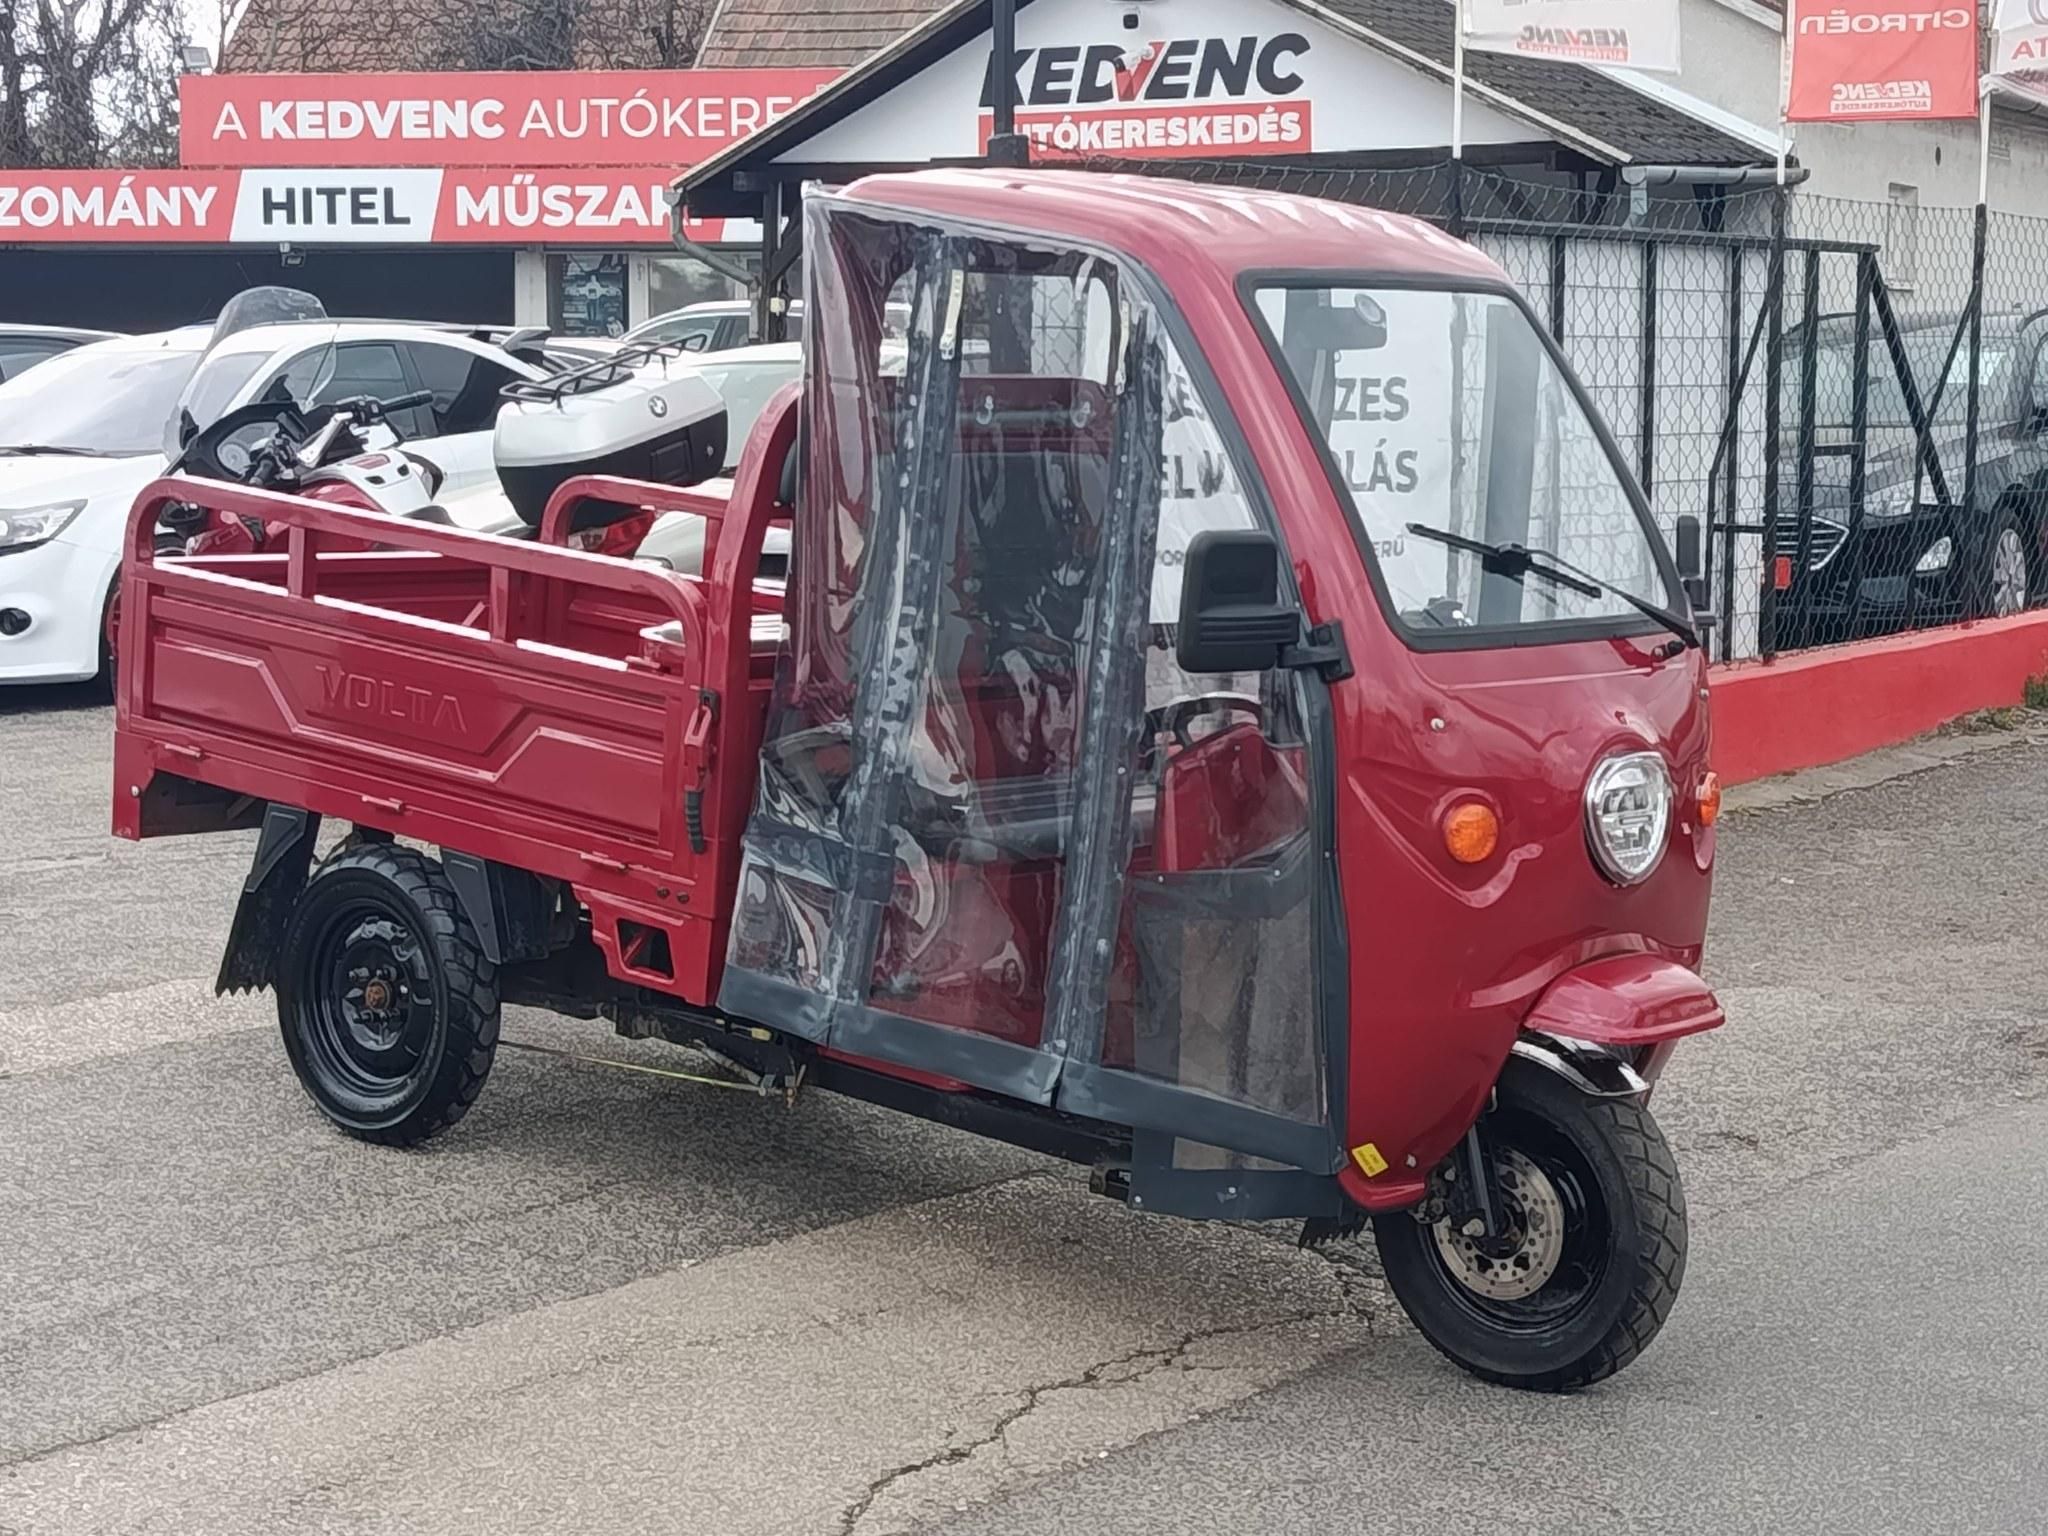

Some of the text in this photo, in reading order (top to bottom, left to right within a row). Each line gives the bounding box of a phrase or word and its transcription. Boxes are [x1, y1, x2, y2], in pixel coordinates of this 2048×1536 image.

[979, 33, 1311, 107] KEDVENC
[212, 88, 817, 140] A KEDVENC AUTÓKERE
[1013, 104, 1302, 151] TÓKERESKEDÉS
[263, 187, 411, 225] HITEL
[455, 174, 702, 227] MŰSZAK
[1331, 438, 1419, 493] LÁS
[315, 665, 468, 735] VOLTA
